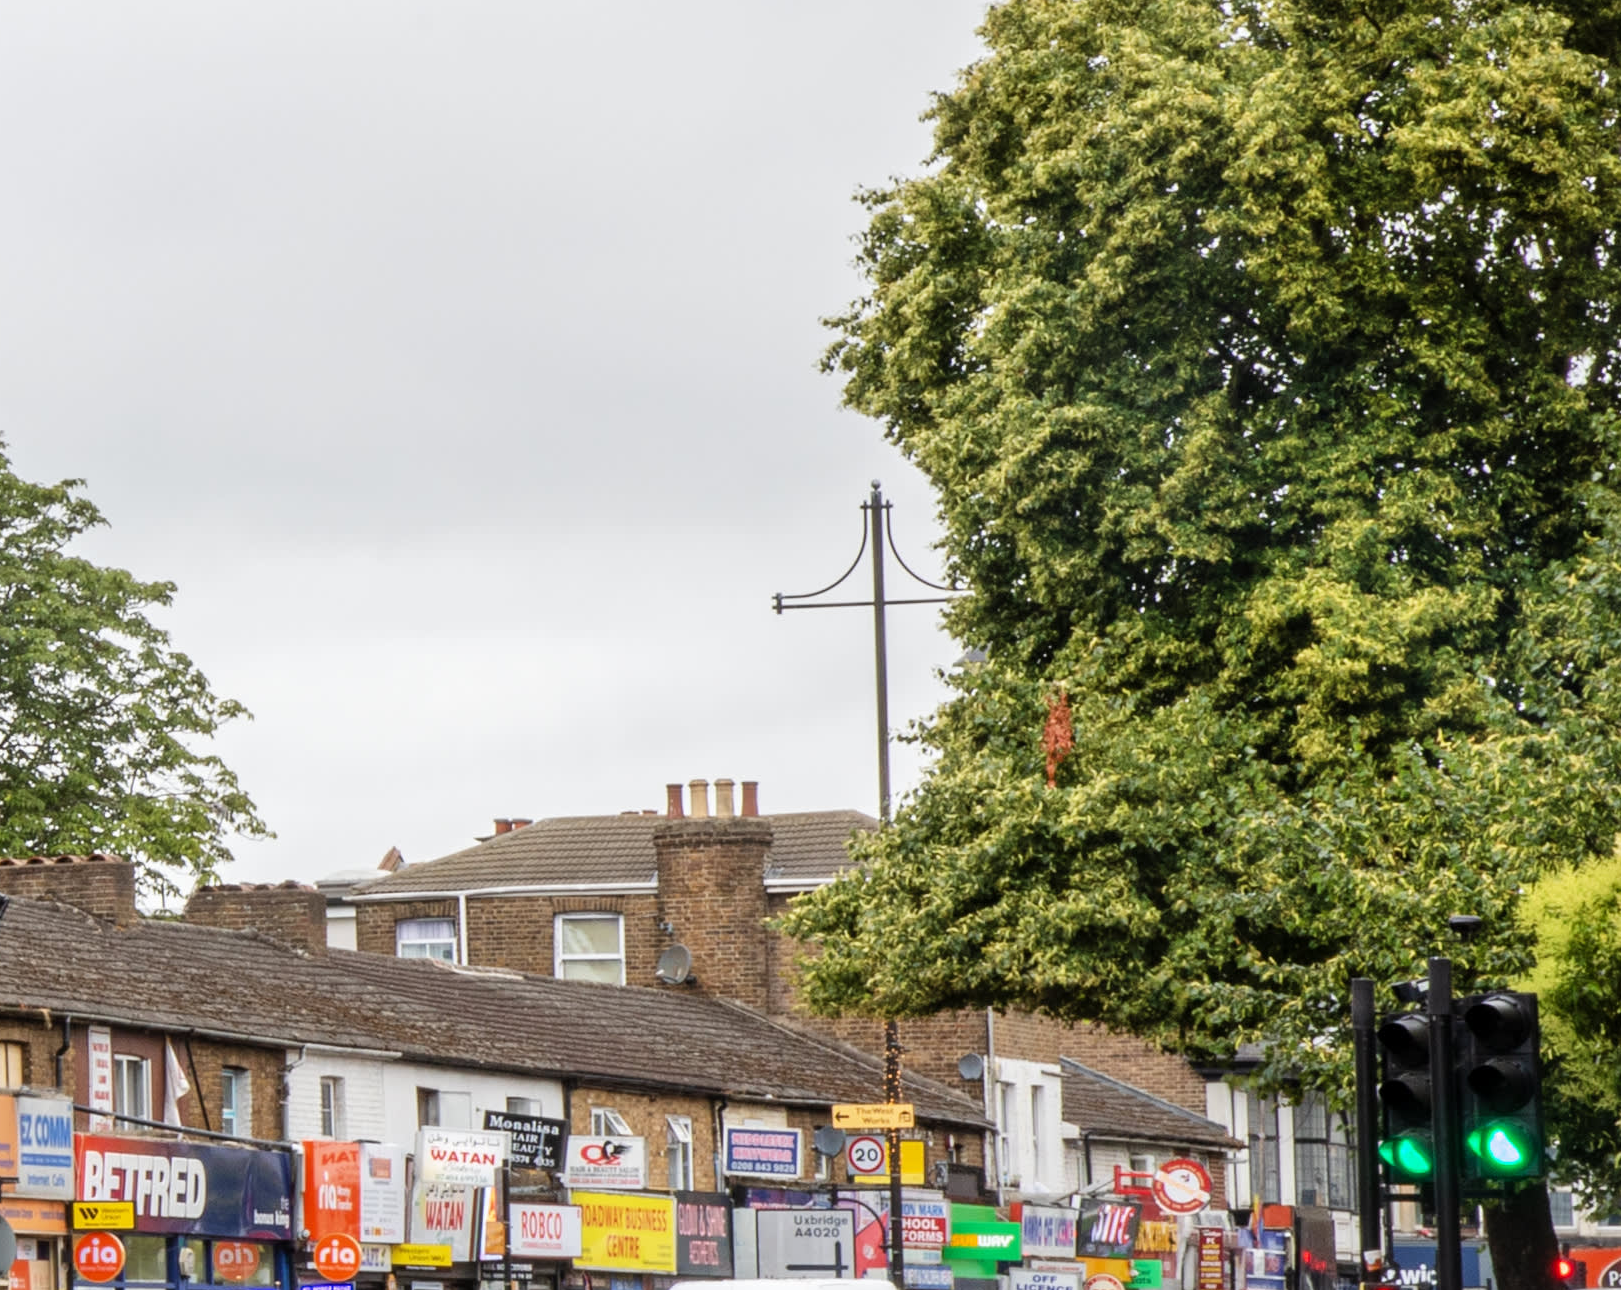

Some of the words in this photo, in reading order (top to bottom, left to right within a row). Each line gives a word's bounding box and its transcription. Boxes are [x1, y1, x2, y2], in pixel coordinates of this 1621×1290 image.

[489, 1115, 560, 1135] Monalisa
[862, 1117, 890, 1125] Works
[20, 1115, 32, 1146] EZ
[34, 1115, 71, 1148] COMM
[731, 1133, 795, 1148] MIDDLESEX
[430, 1149, 495, 1165] WATAN
[855, 1148, 878, 1162] 20
[731, 1161, 752, 1171] 0208
[82, 1149, 207, 1220] BETFRED
[319, 1171, 336, 1210] ria
[254, 1209, 275, 1225] bonus
[275, 1210, 290, 1229] king
[426, 1201, 464, 1230] WATAN
[626, 1208, 667, 1232] BUSINESS
[794, 1215, 848, 1226] Uxbridge
[919, 1205, 944, 1216] MARK
[521, 1211, 562, 1240] ROBCO
[795, 1228, 840, 1238] A4020
[607, 1235, 639, 1259] CENTRE
[952, 1234, 1014, 1247] SUBWAY
[79, 1238, 117, 1264] ria
[320, 1240, 355, 1264] ria
[1032, 1275, 1057, 1283] OFF
